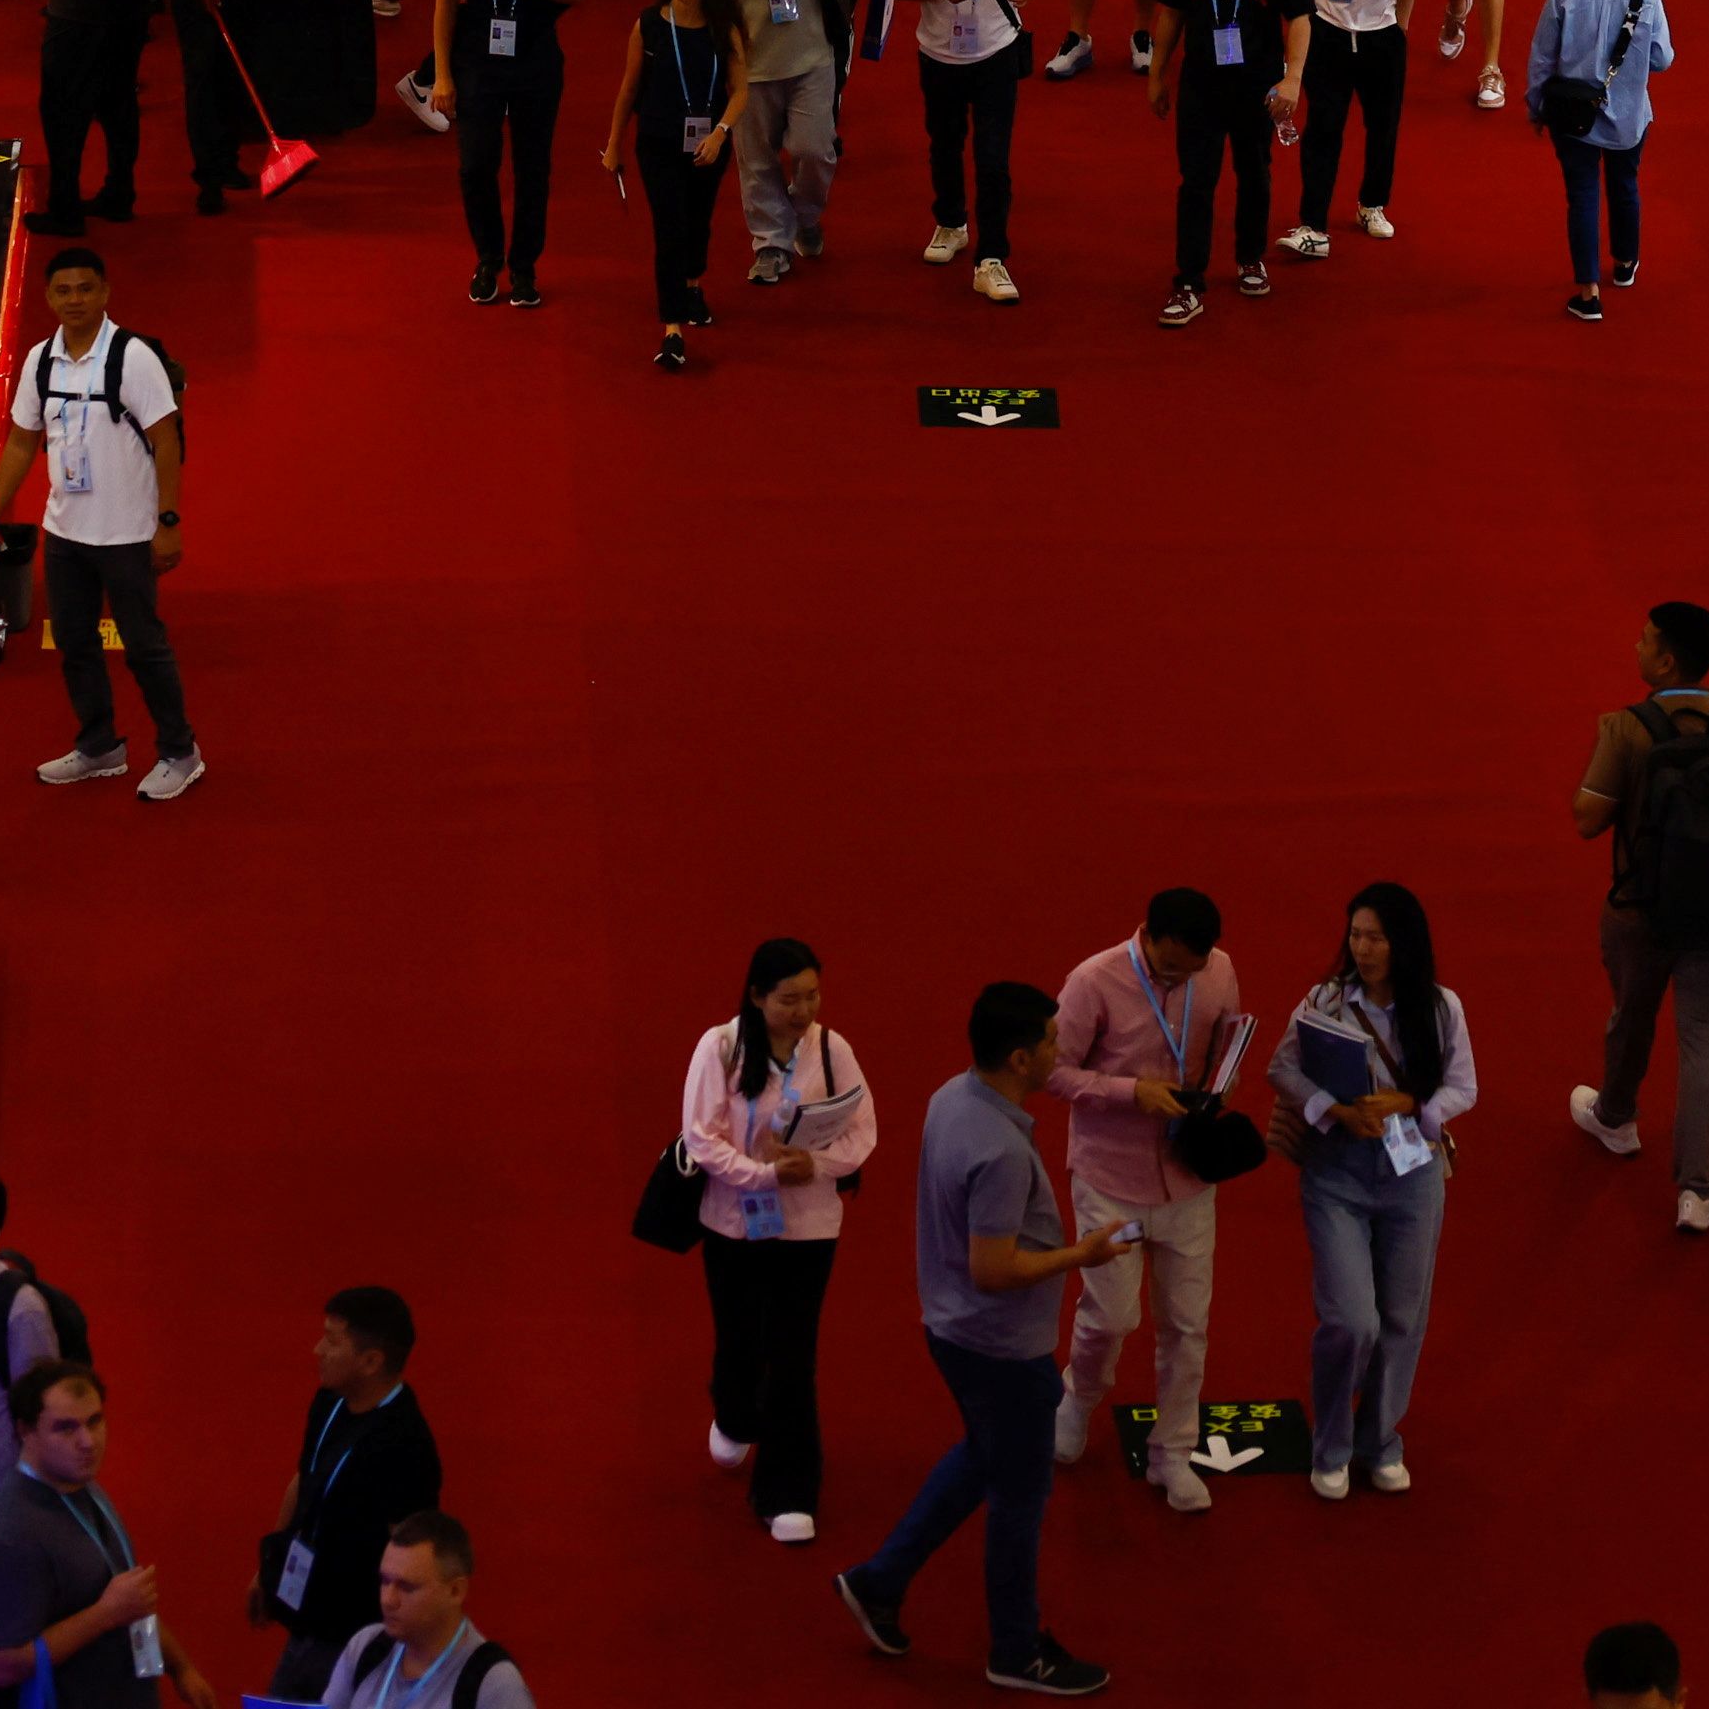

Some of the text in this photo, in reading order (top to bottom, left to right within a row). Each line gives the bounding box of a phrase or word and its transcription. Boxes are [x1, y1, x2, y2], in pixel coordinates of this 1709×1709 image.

[948, 397, 1026, 406] EXIT
[1130, 1403, 1282, 1423] 安全口
[1204, 1420, 1266, 1434] EX
